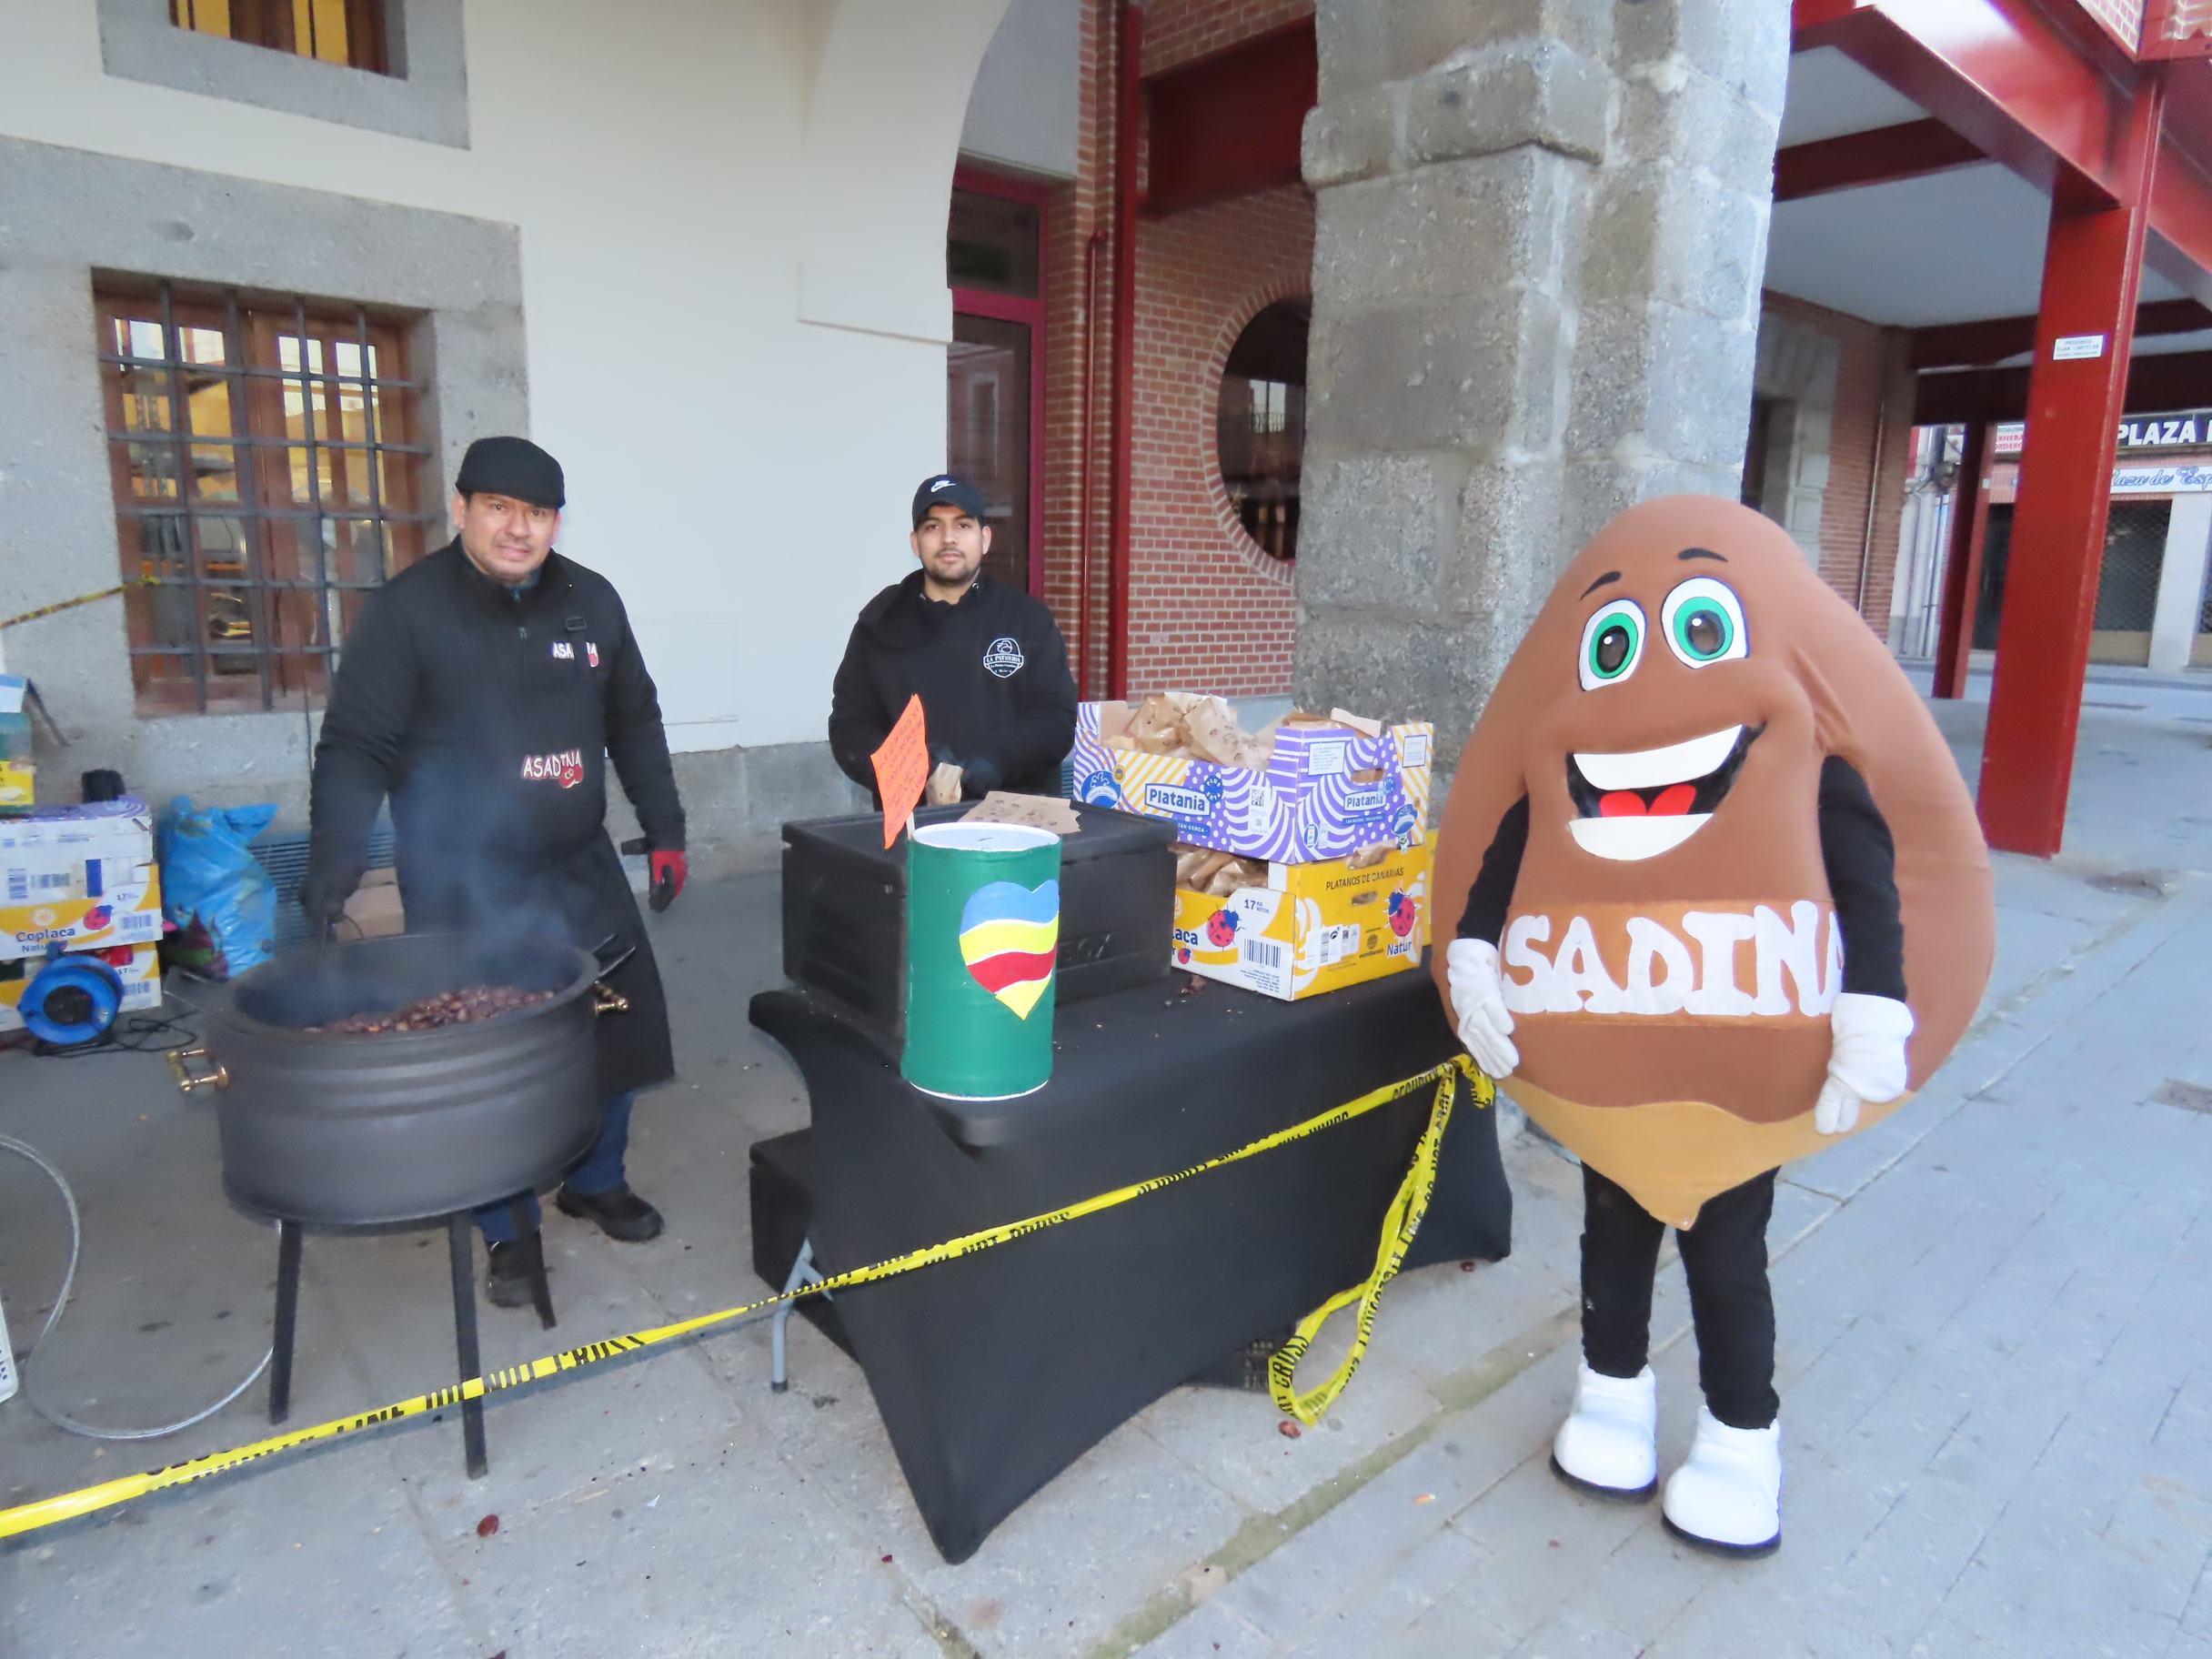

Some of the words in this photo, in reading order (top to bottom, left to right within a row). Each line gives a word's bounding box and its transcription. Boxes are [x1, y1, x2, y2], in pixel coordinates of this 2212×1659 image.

[2117, 419, 2197, 446] PLAZA
[1149, 788, 1205, 811] Platania
[1325, 876, 1361, 891] PLATANOS
[1362, 874, 1370, 884] DE
[1243, 899, 1256, 910] 17
[15, 928, 75, 943] Coplaca
[1171, 928, 1199, 946] aca
[1386, 940, 1413, 956] Natur
